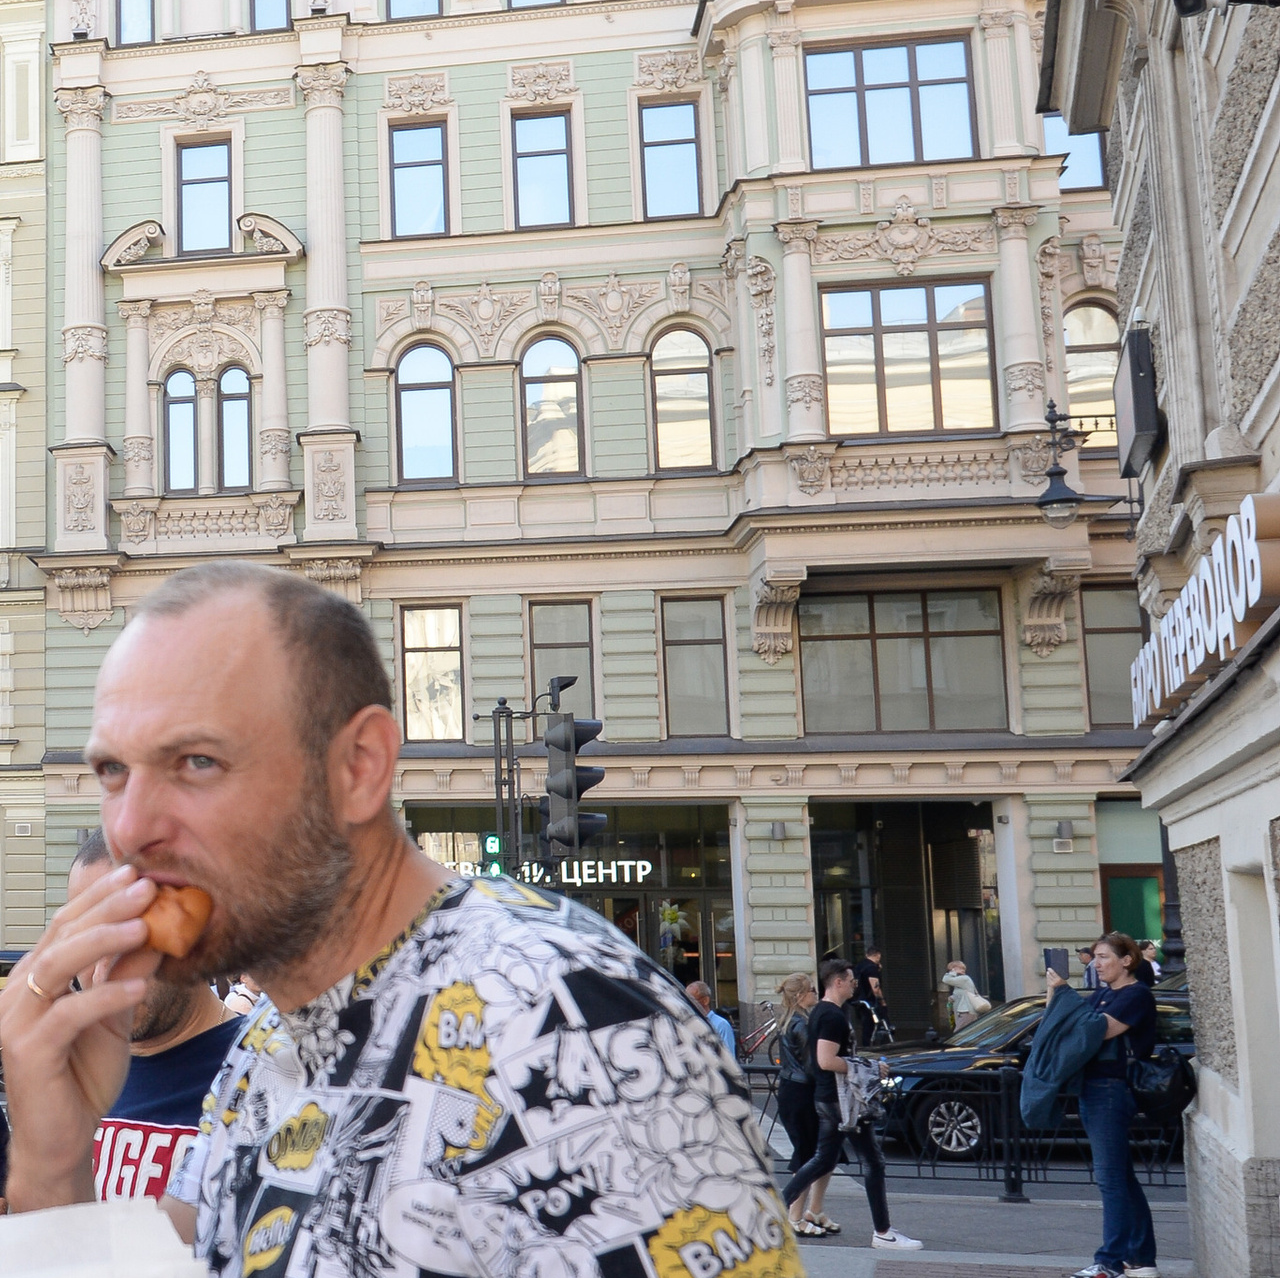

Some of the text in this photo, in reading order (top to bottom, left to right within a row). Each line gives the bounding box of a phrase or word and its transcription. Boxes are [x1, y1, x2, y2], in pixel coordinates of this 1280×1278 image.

[1130, 493, 1263, 730] БЮРО ПЕРЕВОДОВ
[561, 860, 653, 887] ЦЕНТР
